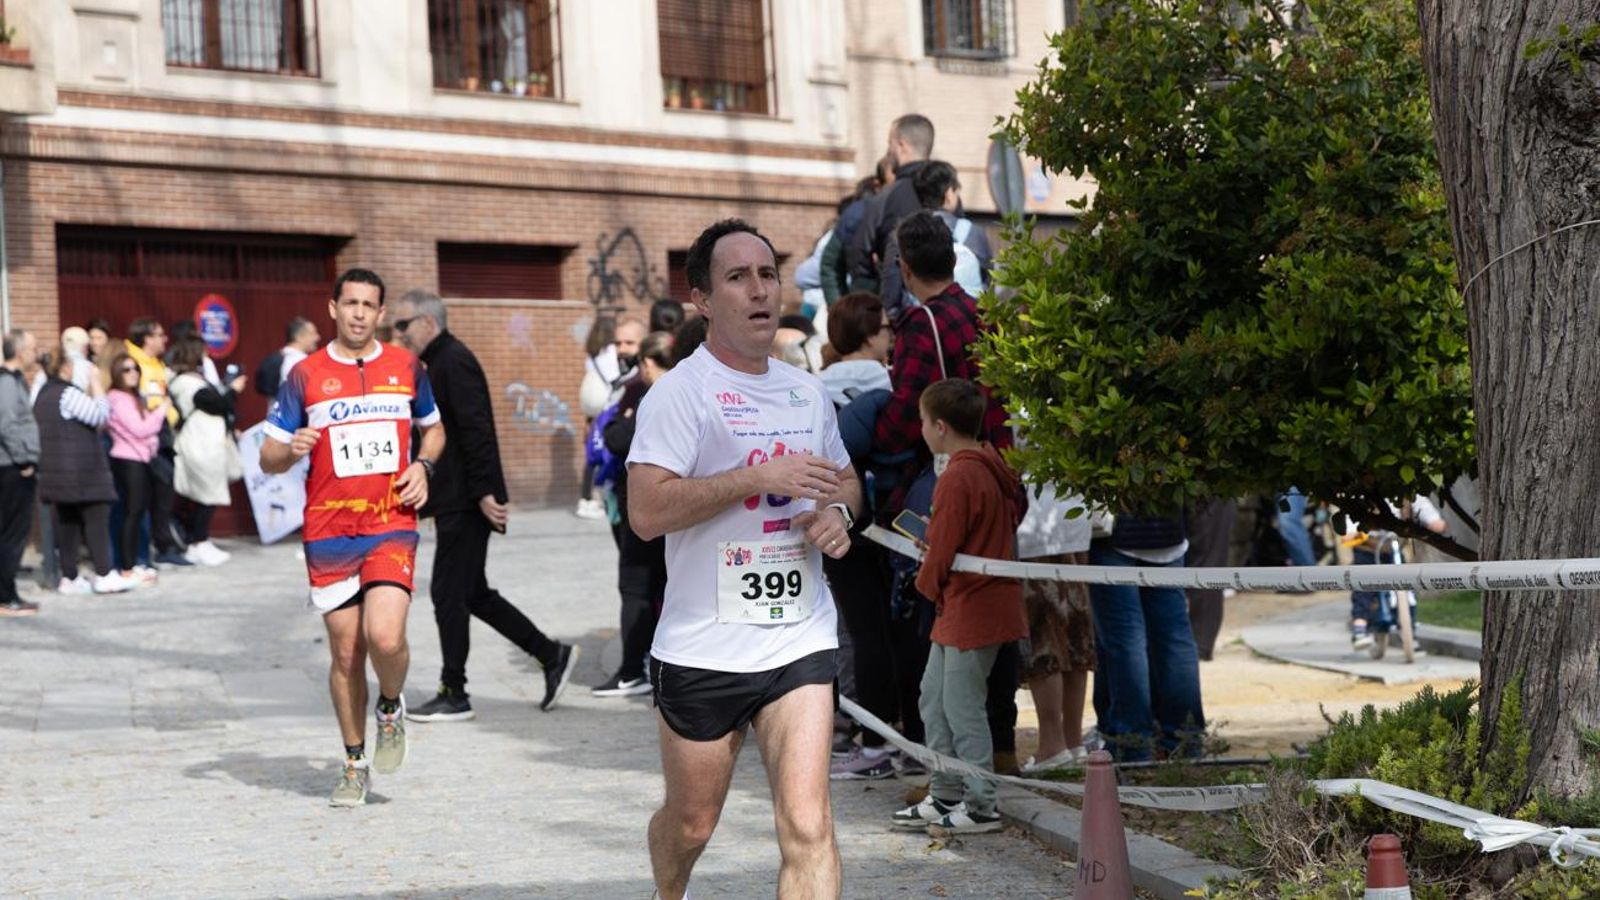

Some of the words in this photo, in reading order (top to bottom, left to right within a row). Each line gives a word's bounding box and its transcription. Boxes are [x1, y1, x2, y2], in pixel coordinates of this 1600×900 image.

[352, 403, 400, 415] Avanza
[340, 440, 394, 460] 1134
[741, 569, 802, 600] 399
[1429, 577, 1467, 589] DEPORTES
[1486, 576, 1526, 588] Ayuntamiento
[1526, 574, 1535, 588] de
